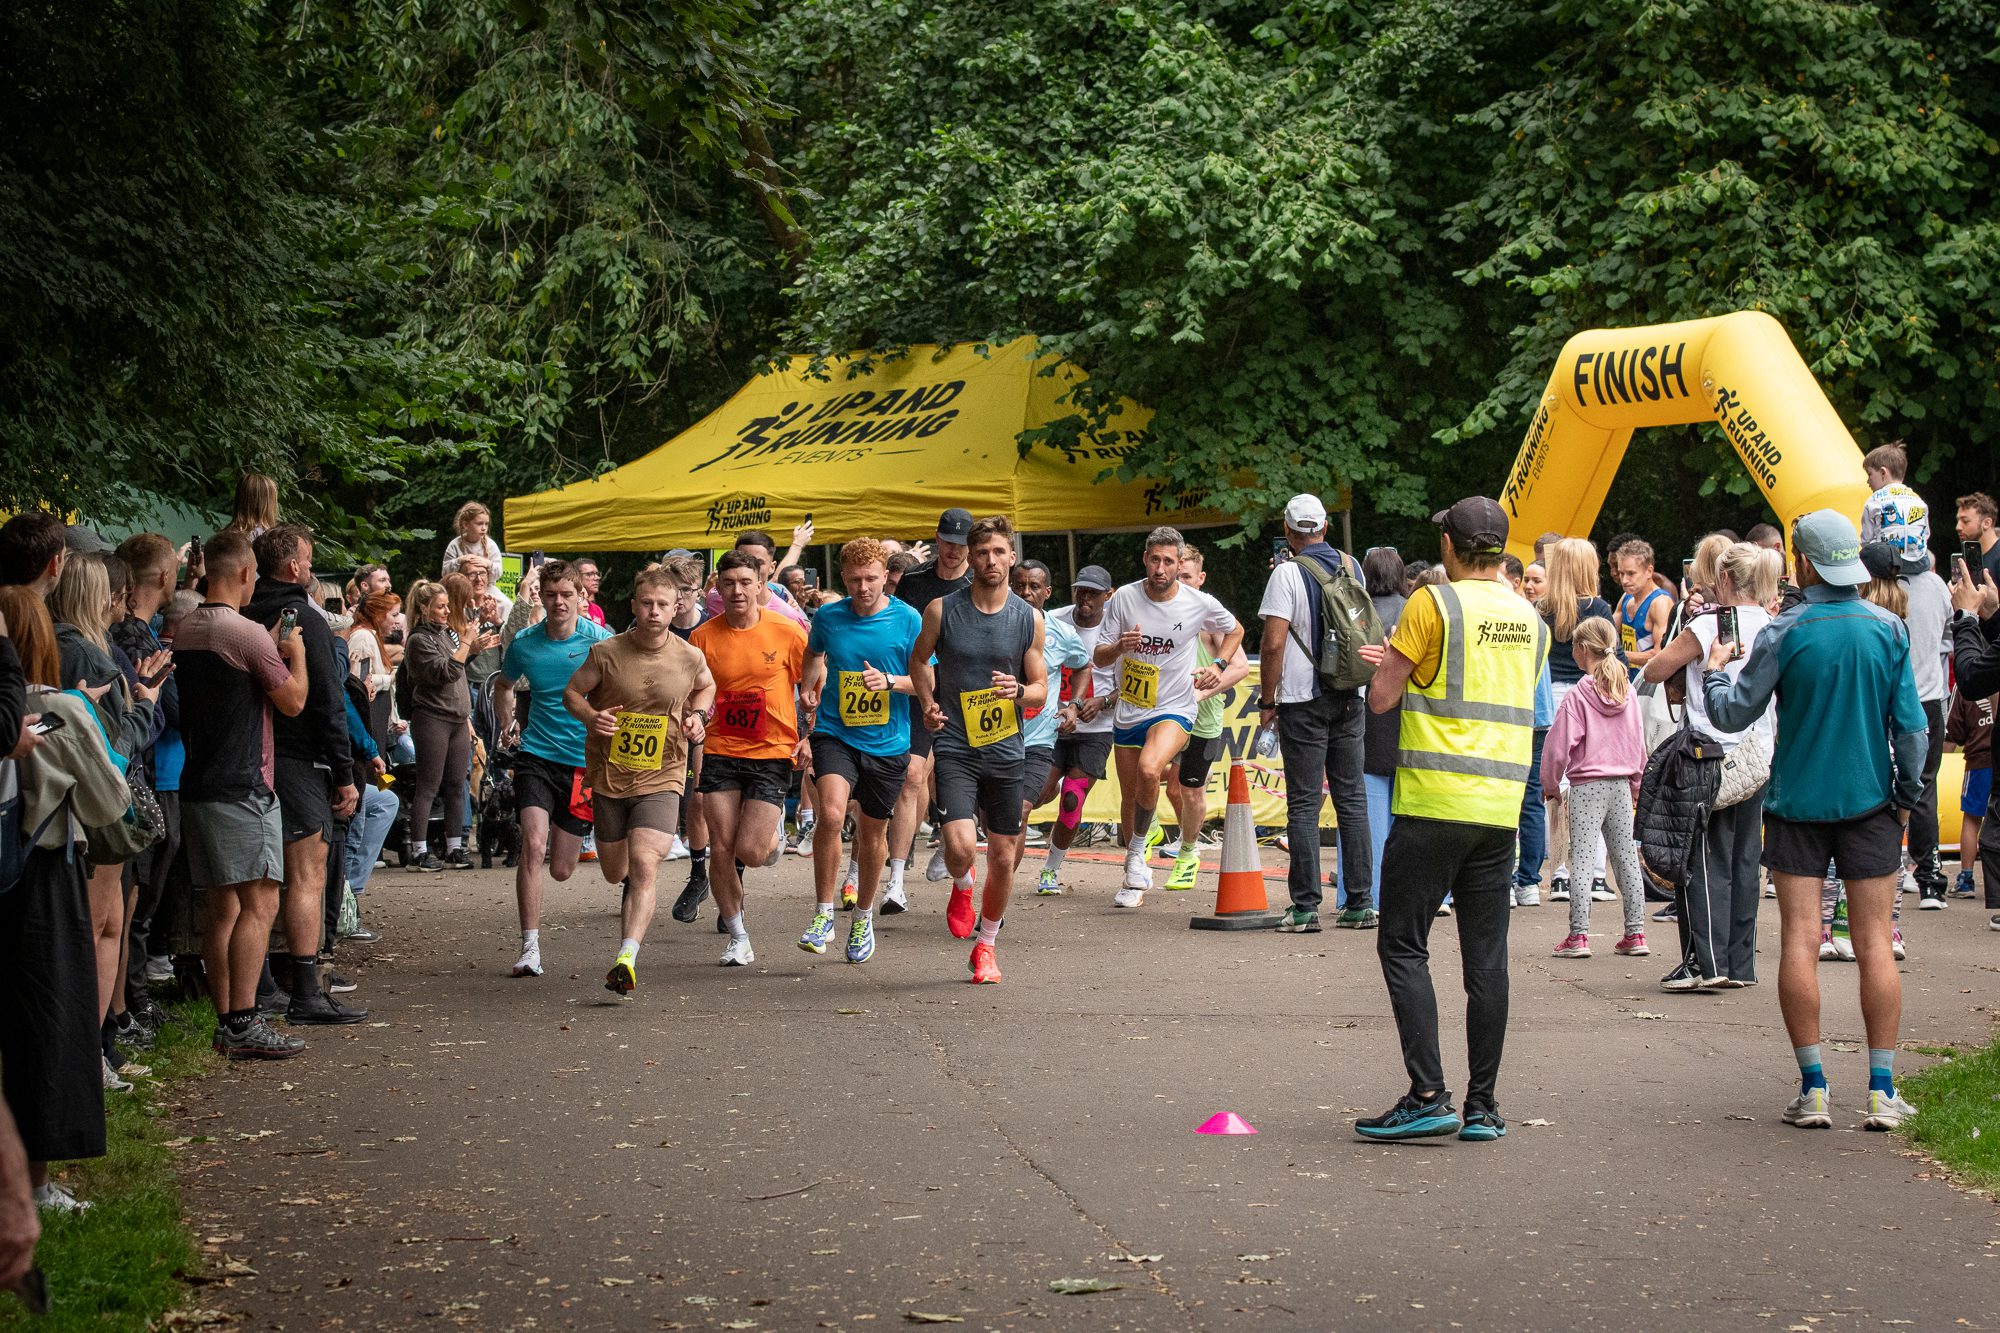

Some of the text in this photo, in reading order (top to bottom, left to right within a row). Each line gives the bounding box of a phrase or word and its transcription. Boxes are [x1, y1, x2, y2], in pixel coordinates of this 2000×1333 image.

[1574, 342, 1690, 407] FINISH
[807, 380, 966, 424] UP AND
[753, 409, 960, 457] RUNNING
[1737, 407, 1758, 432] UP
[1750, 429, 1782, 466] AND
[774, 448, 873, 465] EVENTS
[1516, 405, 1549, 491] RUNNING
[1532, 440, 1550, 481] EVENTS
[1727, 417, 1777, 490] RUNNING
[727, 496, 766, 514] UP AND
[721, 509, 772, 530] RUNNING
[1491, 633, 1532, 644] RUNNING
[1495, 622, 1528, 633] UP AND
[1125, 674, 1149, 699] 271
[846, 691, 882, 714] 266
[725, 708, 760, 729] 687
[980, 706, 1003, 733] 69
[618, 731, 658, 758] 350
